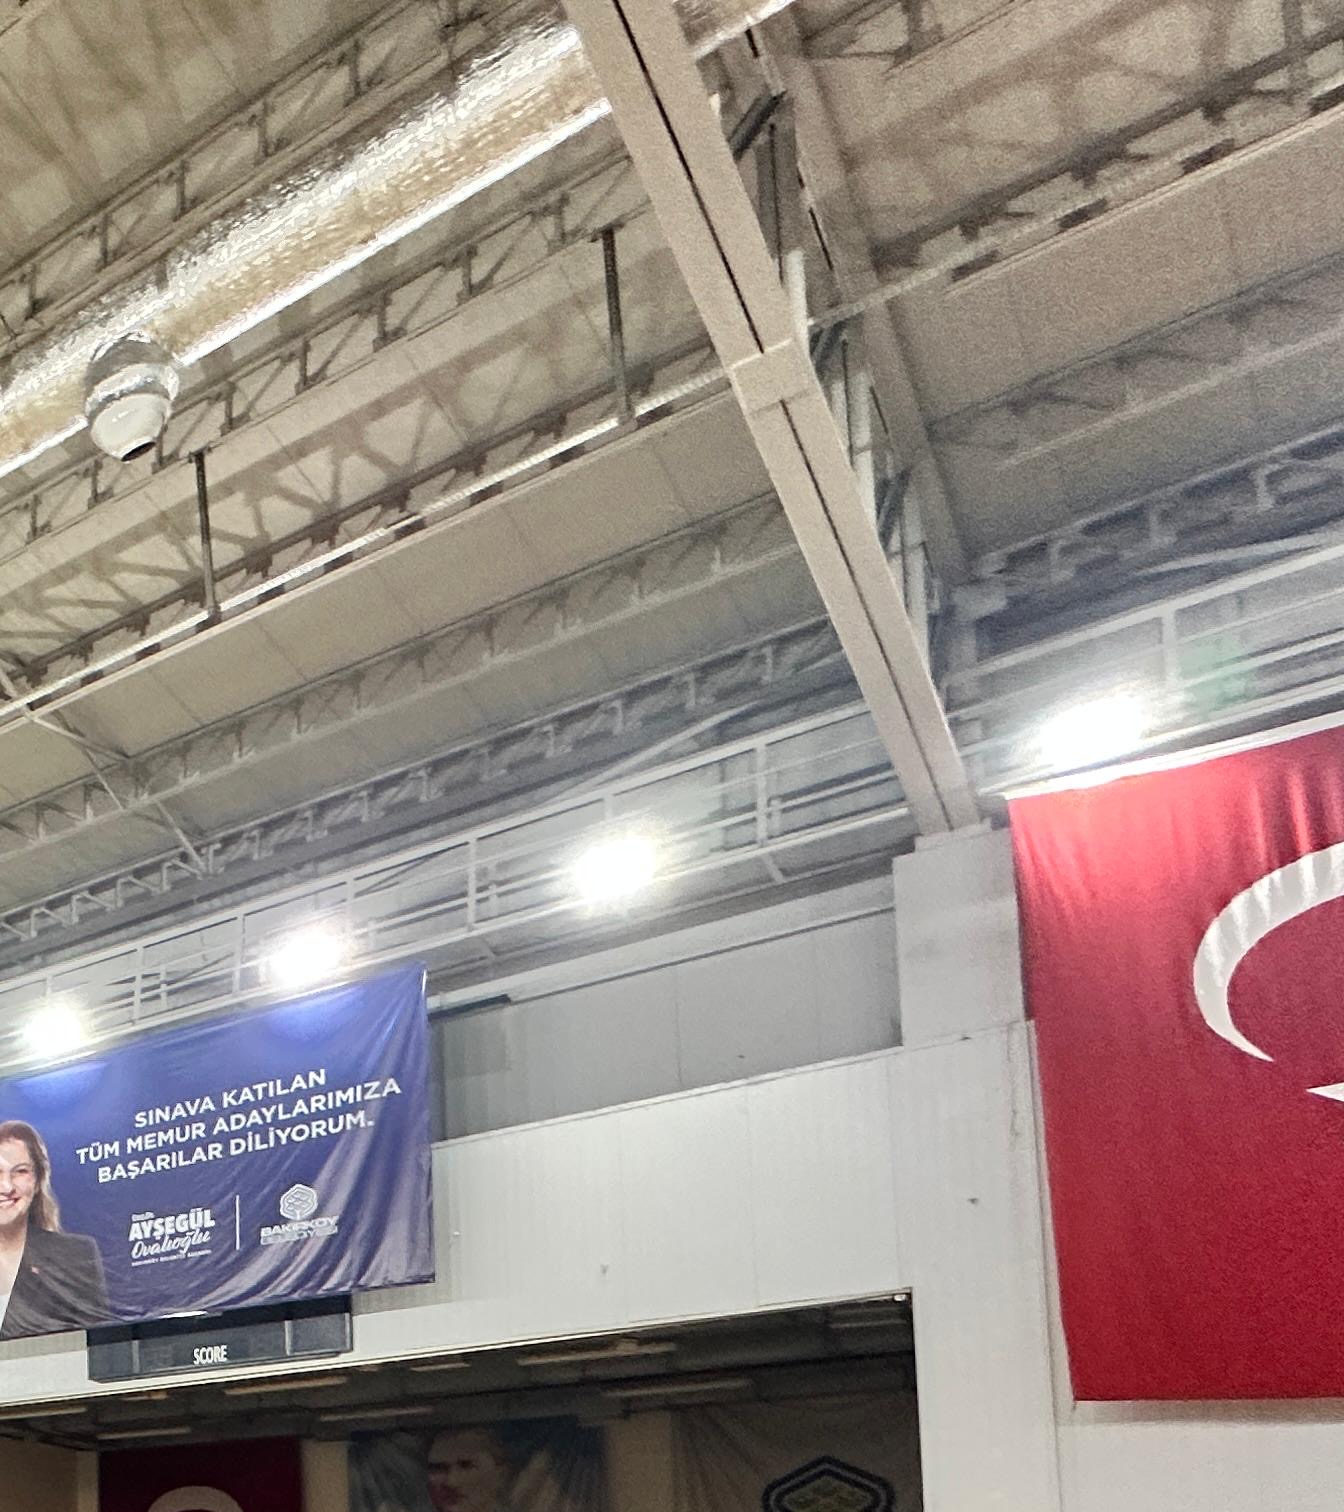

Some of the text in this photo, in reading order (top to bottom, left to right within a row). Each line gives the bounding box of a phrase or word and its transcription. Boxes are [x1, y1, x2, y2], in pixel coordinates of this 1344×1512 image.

[75, 1077, 402, 1165] TÜM MEMUR ADAYLARIMIZA
[134, 1068, 327, 1129] SINAVA KATILAN
[98, 1109, 376, 1184] BAŞARILAR DİLİYORUM.
[128, 1207, 216, 1241] AYŞEGÜL
[193, 1344, 228, 1365] SCORE
